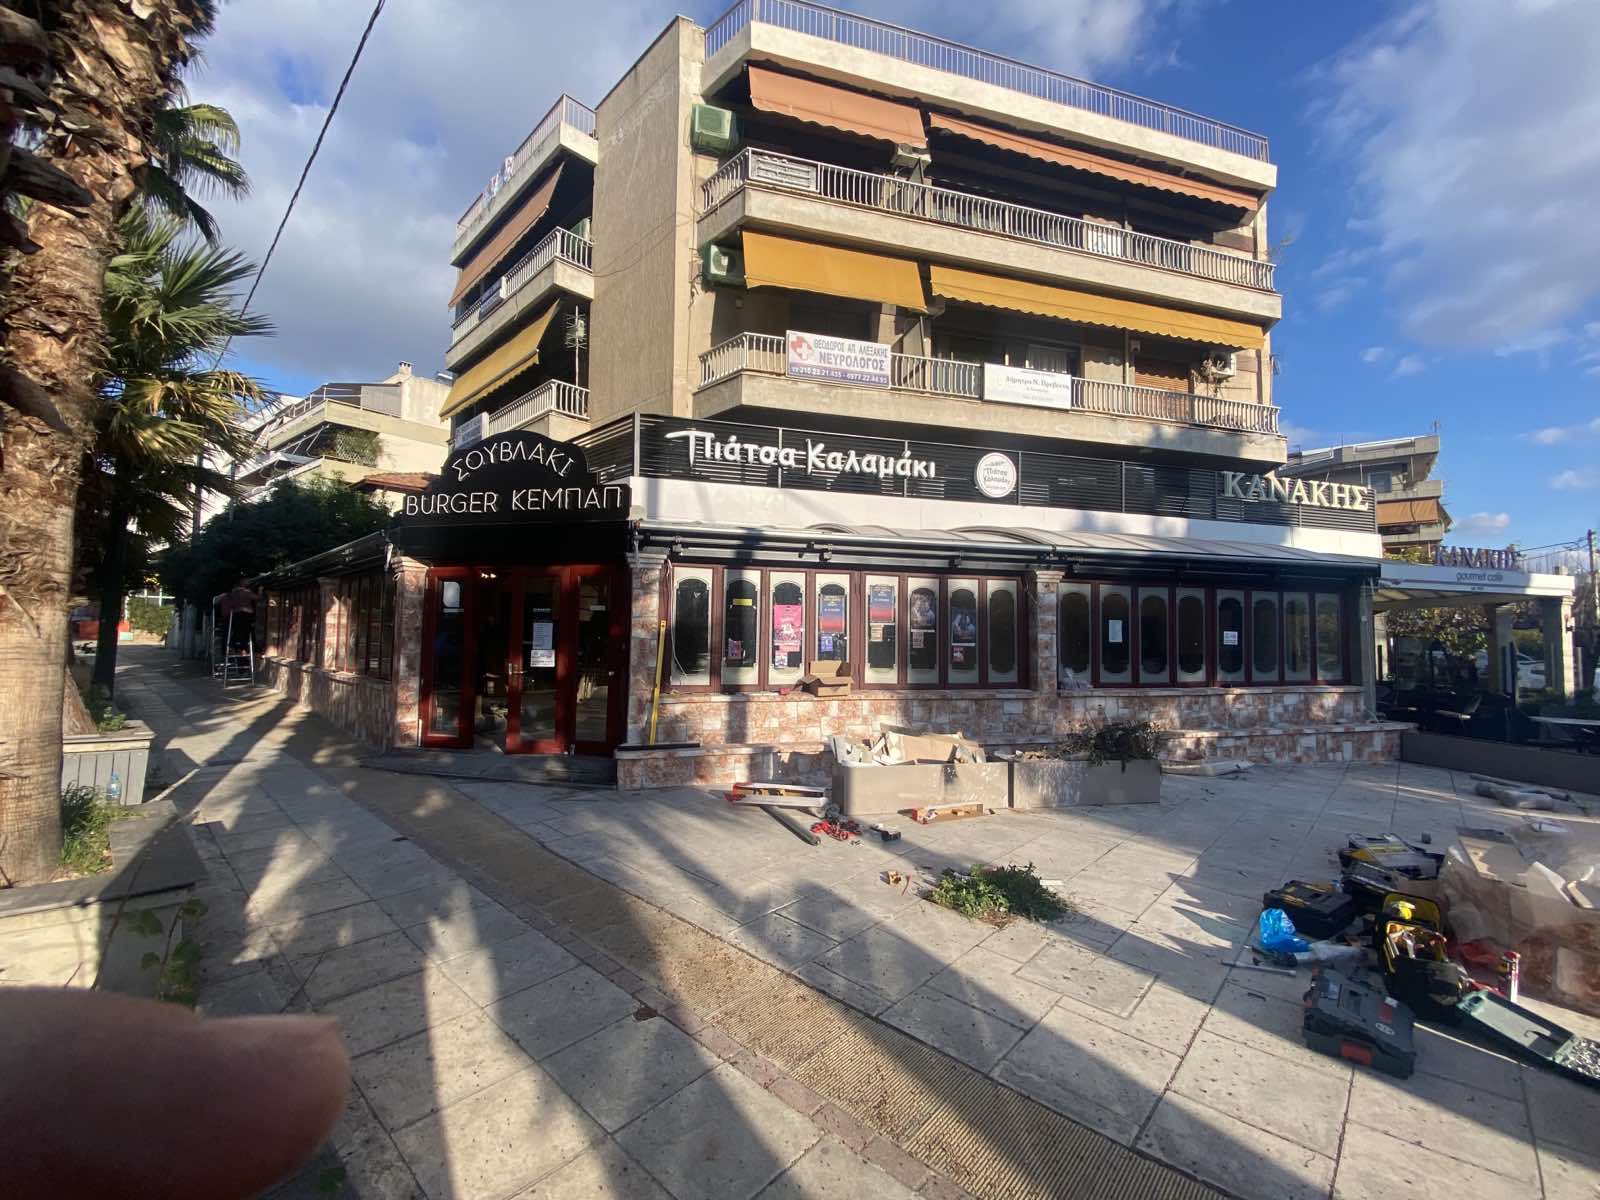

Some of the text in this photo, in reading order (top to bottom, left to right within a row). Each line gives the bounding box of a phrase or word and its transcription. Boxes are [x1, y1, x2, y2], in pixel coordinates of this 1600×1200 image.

[819, 351, 885, 370] ΝΕΥΡΟΛΟΓΟΣ
[451, 440, 574, 482] ΣΟΥΒΛΑΚΙ
[665, 429, 936, 478] Πιάτσα Καλαμάκι
[406, 486, 621, 516] BURGER ΚΕΜΠΑΠ
[1221, 469, 1369, 511] ΚΑΝΑΚΗΣ
